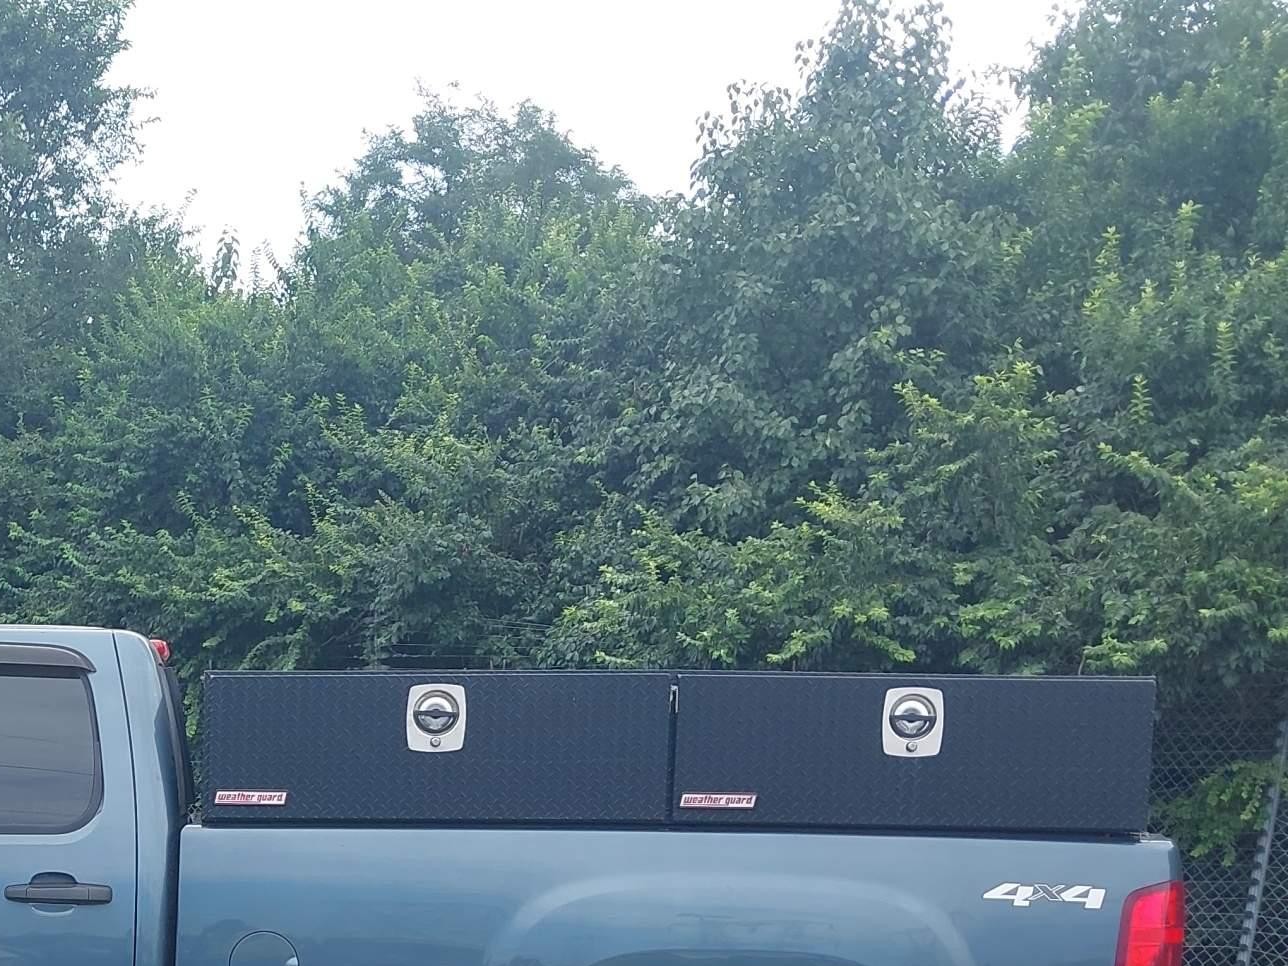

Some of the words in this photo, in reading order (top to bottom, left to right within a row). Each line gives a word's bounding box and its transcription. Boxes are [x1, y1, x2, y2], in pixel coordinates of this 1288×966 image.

[217, 793, 257, 801] weather
[257, 793, 284, 803] guard
[683, 795, 724, 804] weather
[724, 796, 752, 806] guard
